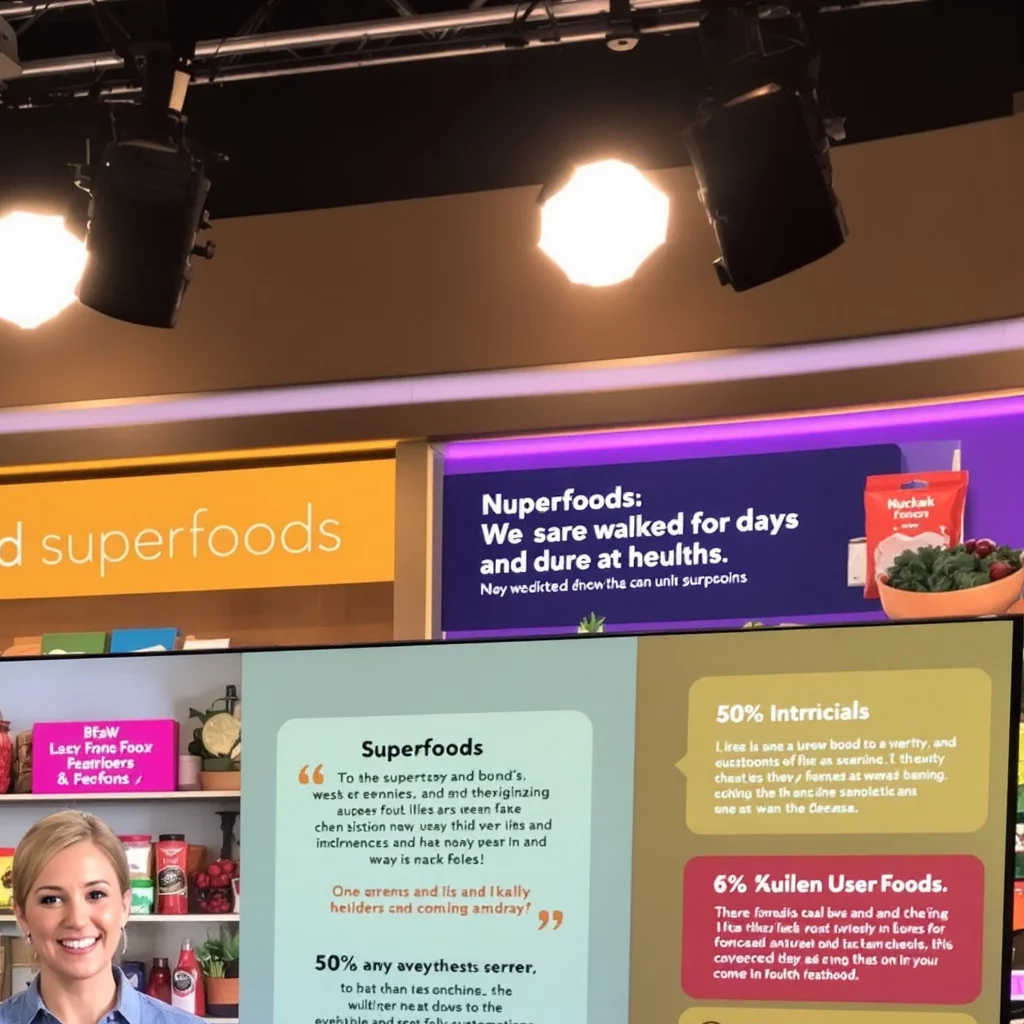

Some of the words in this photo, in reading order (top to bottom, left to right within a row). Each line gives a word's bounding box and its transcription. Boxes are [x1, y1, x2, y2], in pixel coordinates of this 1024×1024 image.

[481, 485, 643, 520] Nuperfoods:
[481, 522, 524, 545] We
[533, 524, 589, 543] sare
[593, 511, 684, 540] walked
[691, 511, 731, 535] for
[736, 507, 800, 536] days
[41, 503, 342, 577] superfoods
[480, 550, 527, 575] and
[533, 549, 592, 573] dure
[597, 549, 623, 569] at
[717, 704, 764, 723] 50%
[933, 736, 957, 748] and
[361, 737, 484, 762] Superfoods
[338, 772, 355, 784] To
[451, 770, 474, 782] and
[421, 787, 444, 799] and
[756, 787, 776, 798] the
[315, 821, 343, 832] chen
[529, 818, 552, 830] and
[393, 836, 416, 848] and
[523, 836, 547, 847] and
[401, 854, 410, 865] is
[713, 874, 748, 893] 6%
[828, 874, 878, 893] User
[880, 873, 948, 893] Foods.
[332, 885, 360, 897] One
[414, 885, 438, 897] and
[461, 885, 486, 897] and
[714, 905, 751, 918] There
[850, 906, 874, 918] and
[876, 906, 901, 918] and
[315, 954, 358, 971] 50%
[362, 961, 393, 974] any
[713, 969, 748, 980] come
[340, 983, 353, 993] to
[466, 1003, 479, 1012] to
[482, 1001, 503, 1013] the
